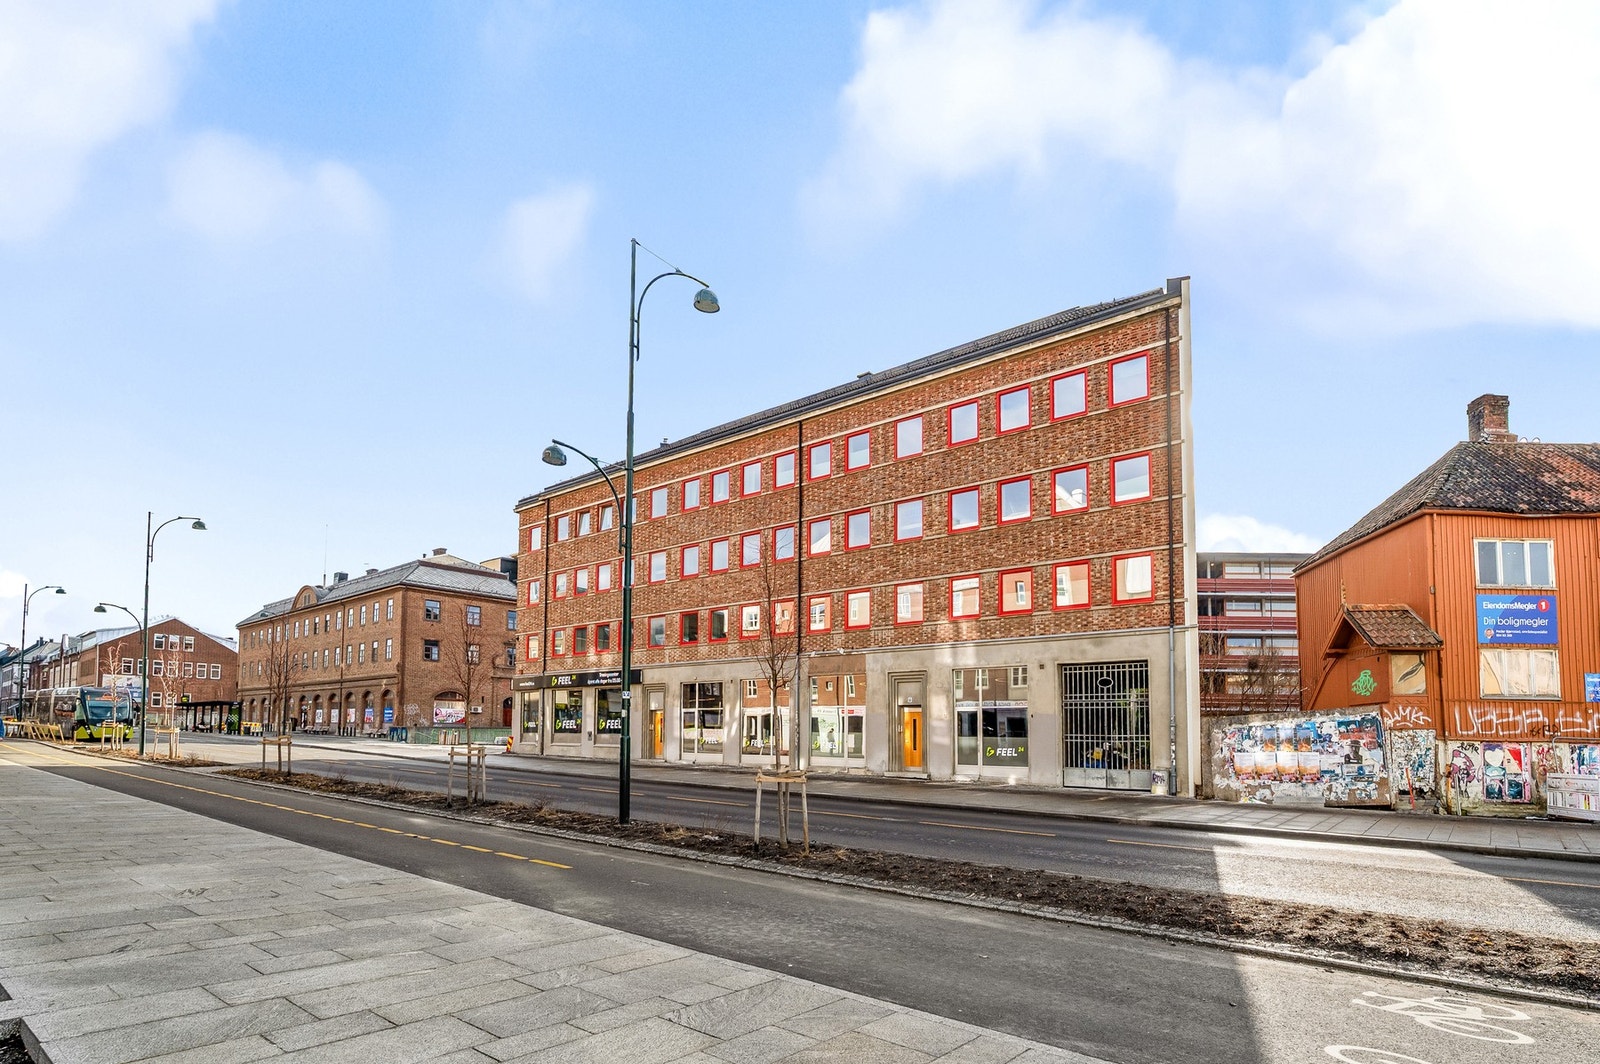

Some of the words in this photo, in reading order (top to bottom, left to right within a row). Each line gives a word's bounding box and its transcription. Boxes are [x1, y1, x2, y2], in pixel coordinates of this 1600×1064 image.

[1483, 616, 1496, 625] Din
[1497, 616, 1549, 627] boligmegler
[558, 676, 572, 685] FEEL
[562, 720, 577, 729] FEEL
[606, 720, 622, 729] FEEL
[996, 748, 1018, 756] FEEL
